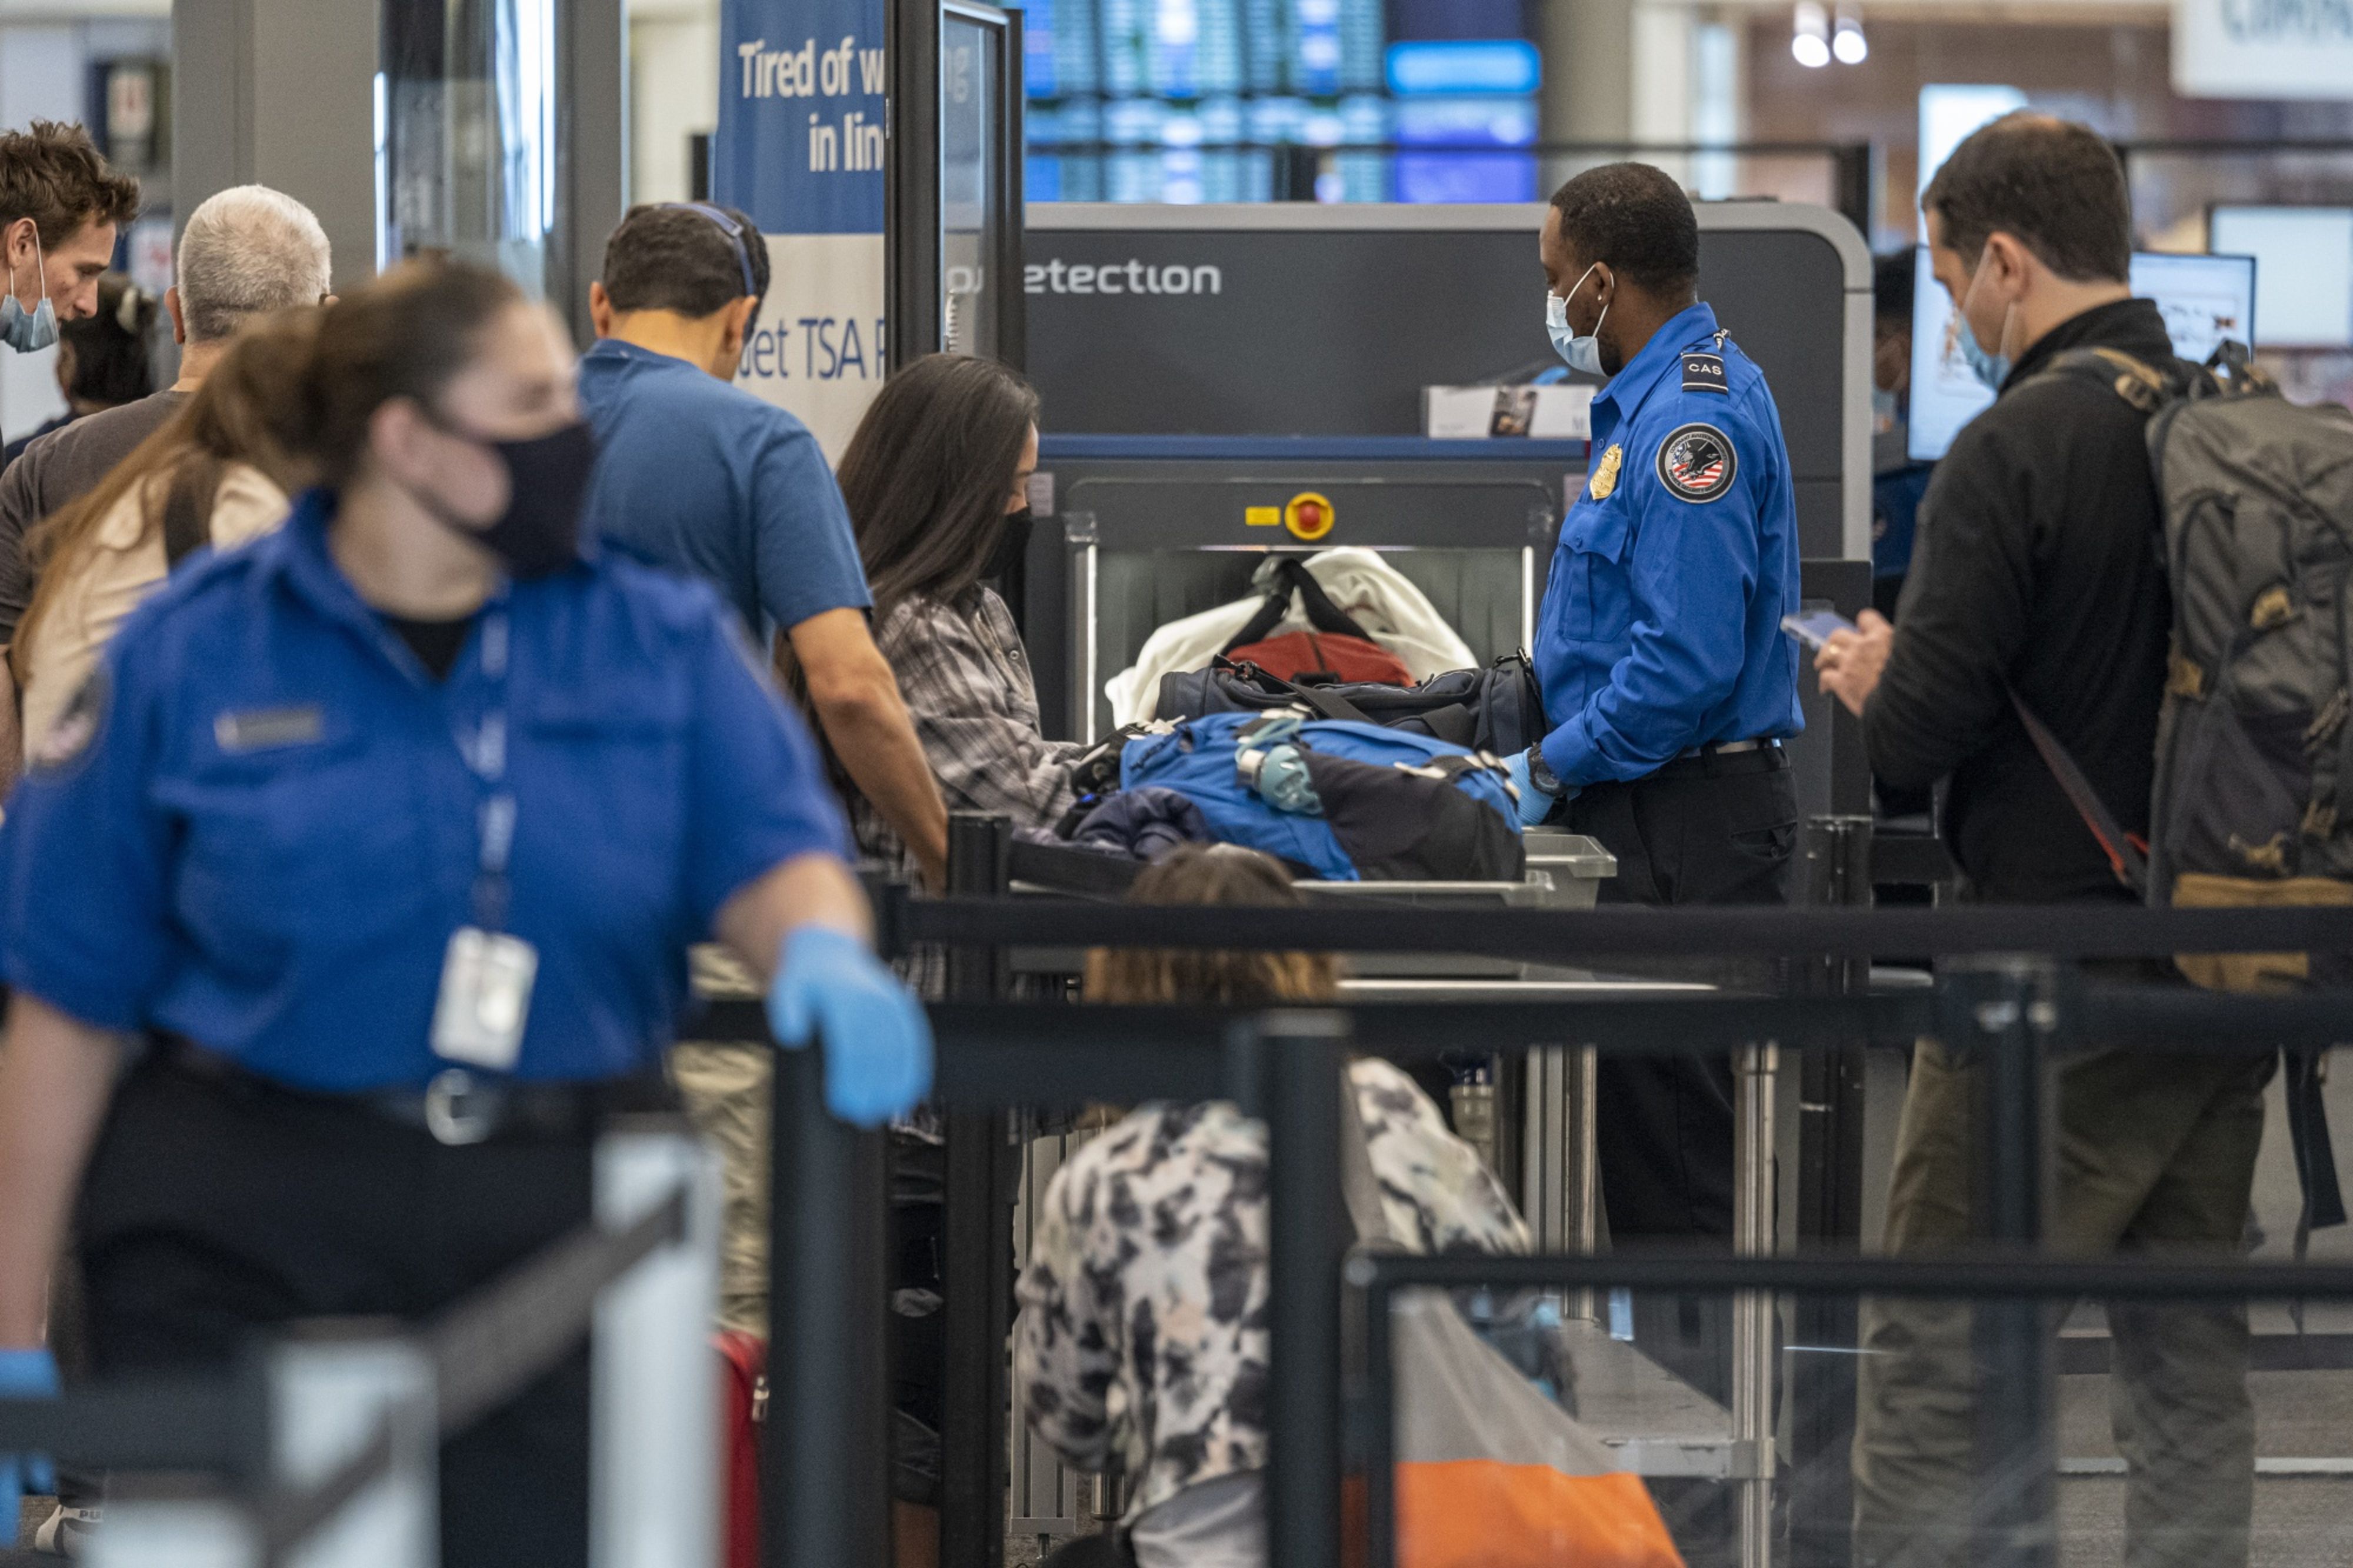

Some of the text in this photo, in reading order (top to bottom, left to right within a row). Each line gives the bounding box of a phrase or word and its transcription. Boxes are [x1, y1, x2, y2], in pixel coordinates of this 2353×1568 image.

[738, 38, 816, 99] Tired
[821, 35, 855, 97] of
[809, 112, 884, 172] in lin
[1024, 259, 1222, 294] etection
[798, 318, 866, 379] TSA
[1689, 363, 1722, 375] CAS
